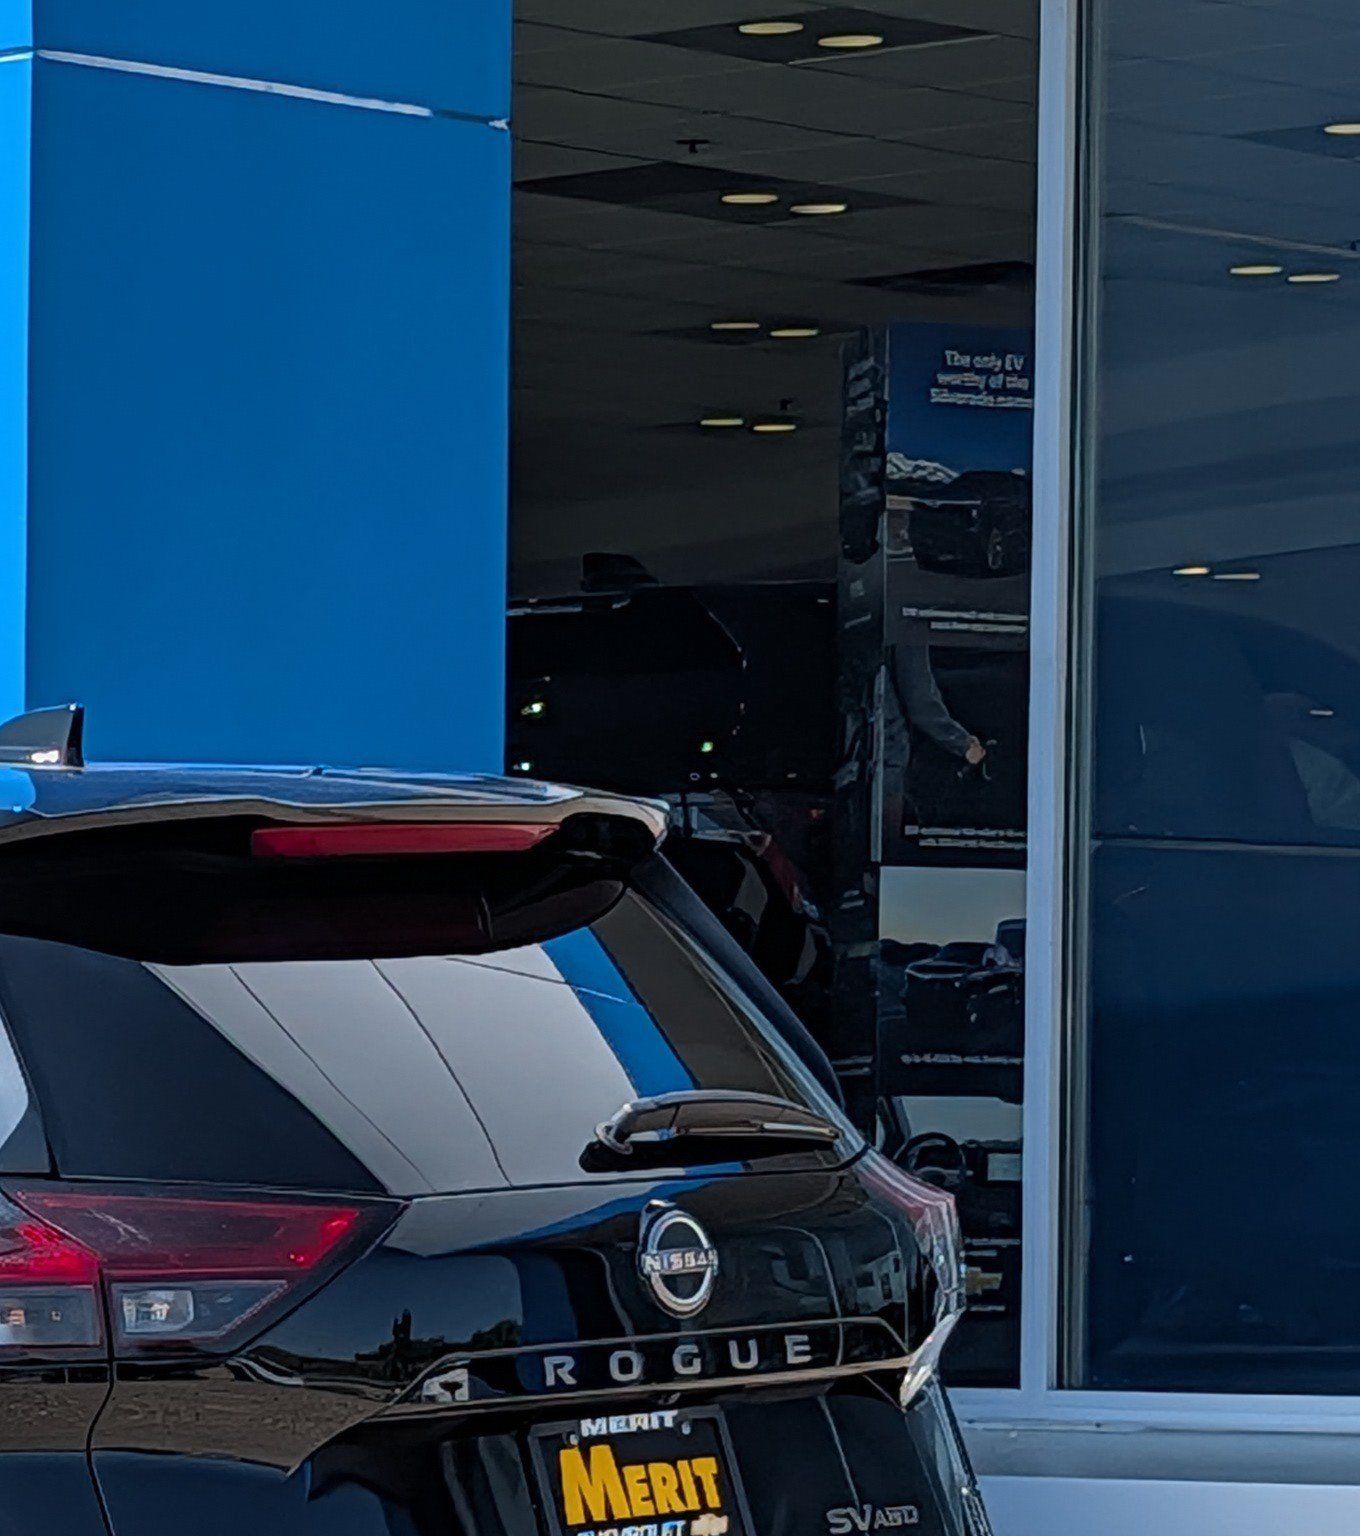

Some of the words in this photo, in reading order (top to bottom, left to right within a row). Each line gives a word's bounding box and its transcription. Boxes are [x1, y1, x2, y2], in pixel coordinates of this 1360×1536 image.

[944, 349, 971, 367] The
[641, 1249, 718, 1275] NISSAN
[543, 1334, 812, 1387] ROGUE
[580, 1409, 678, 1438] MERIT
